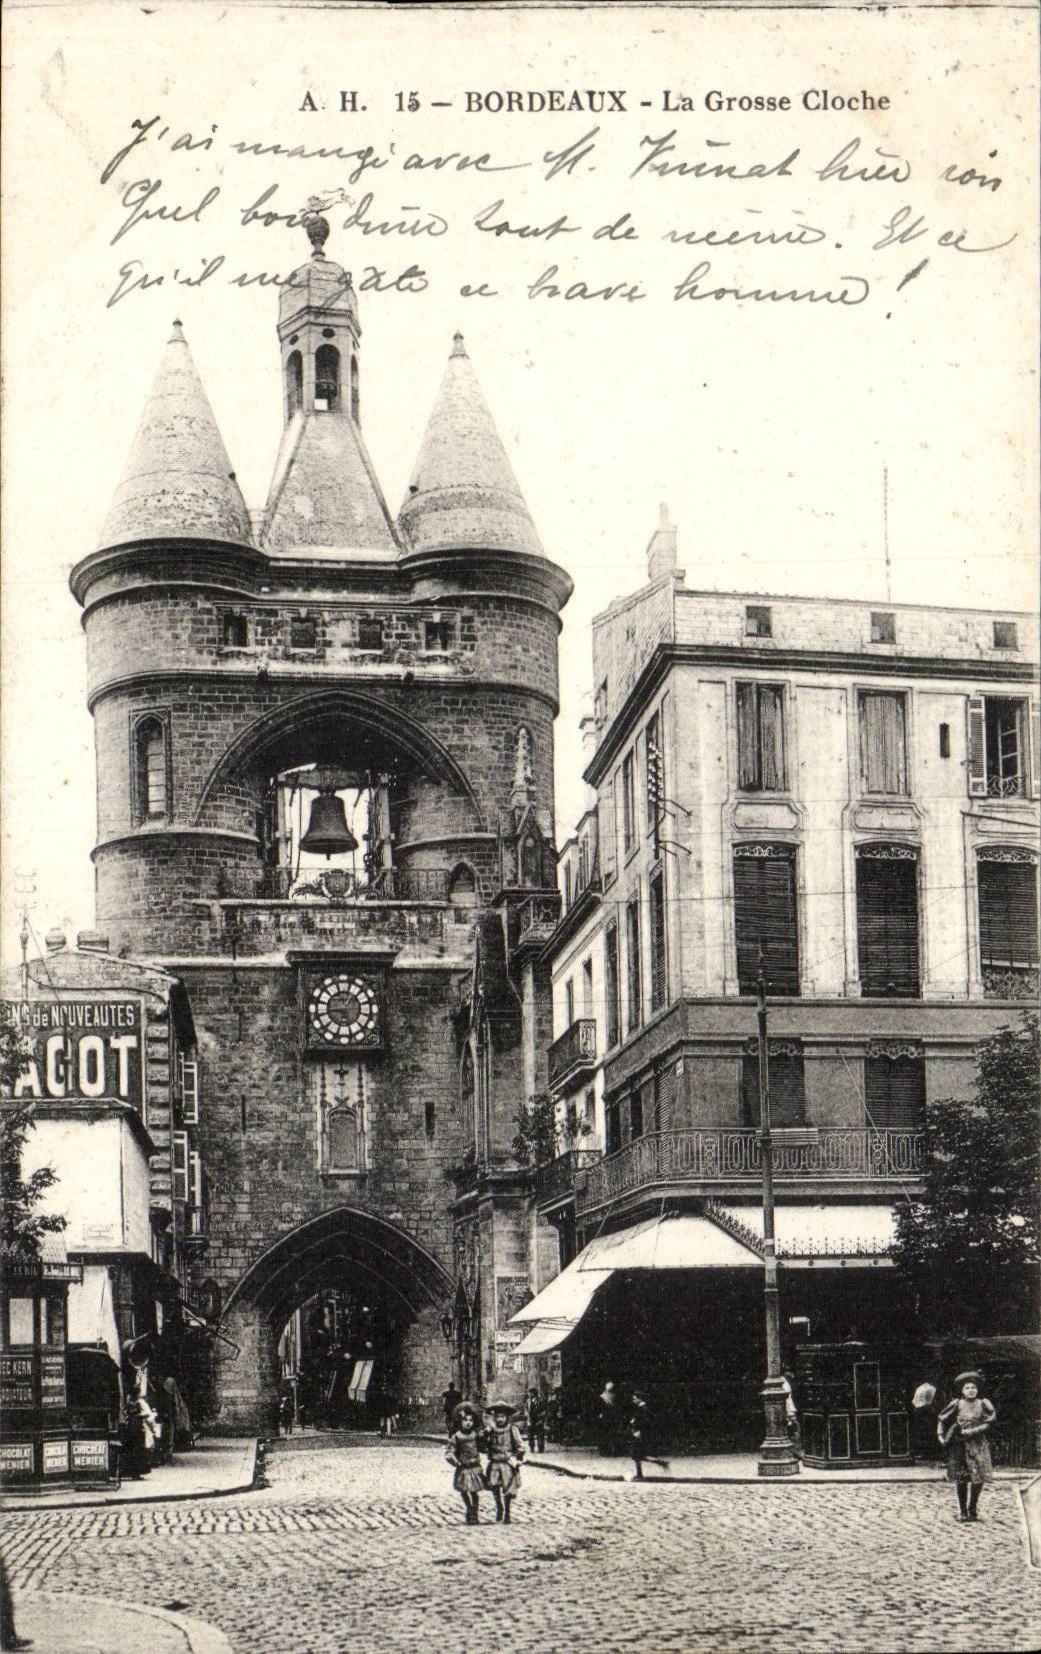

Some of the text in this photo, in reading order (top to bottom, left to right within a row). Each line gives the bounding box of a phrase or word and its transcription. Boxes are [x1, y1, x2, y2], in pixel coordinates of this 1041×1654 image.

[402, 152, 533, 173] avec
[110, 178, 221, 246] Quel
[473, 199, 583, 240] tout
[592, 213, 640, 241] de
[33, 1007, 49, 1027] de
